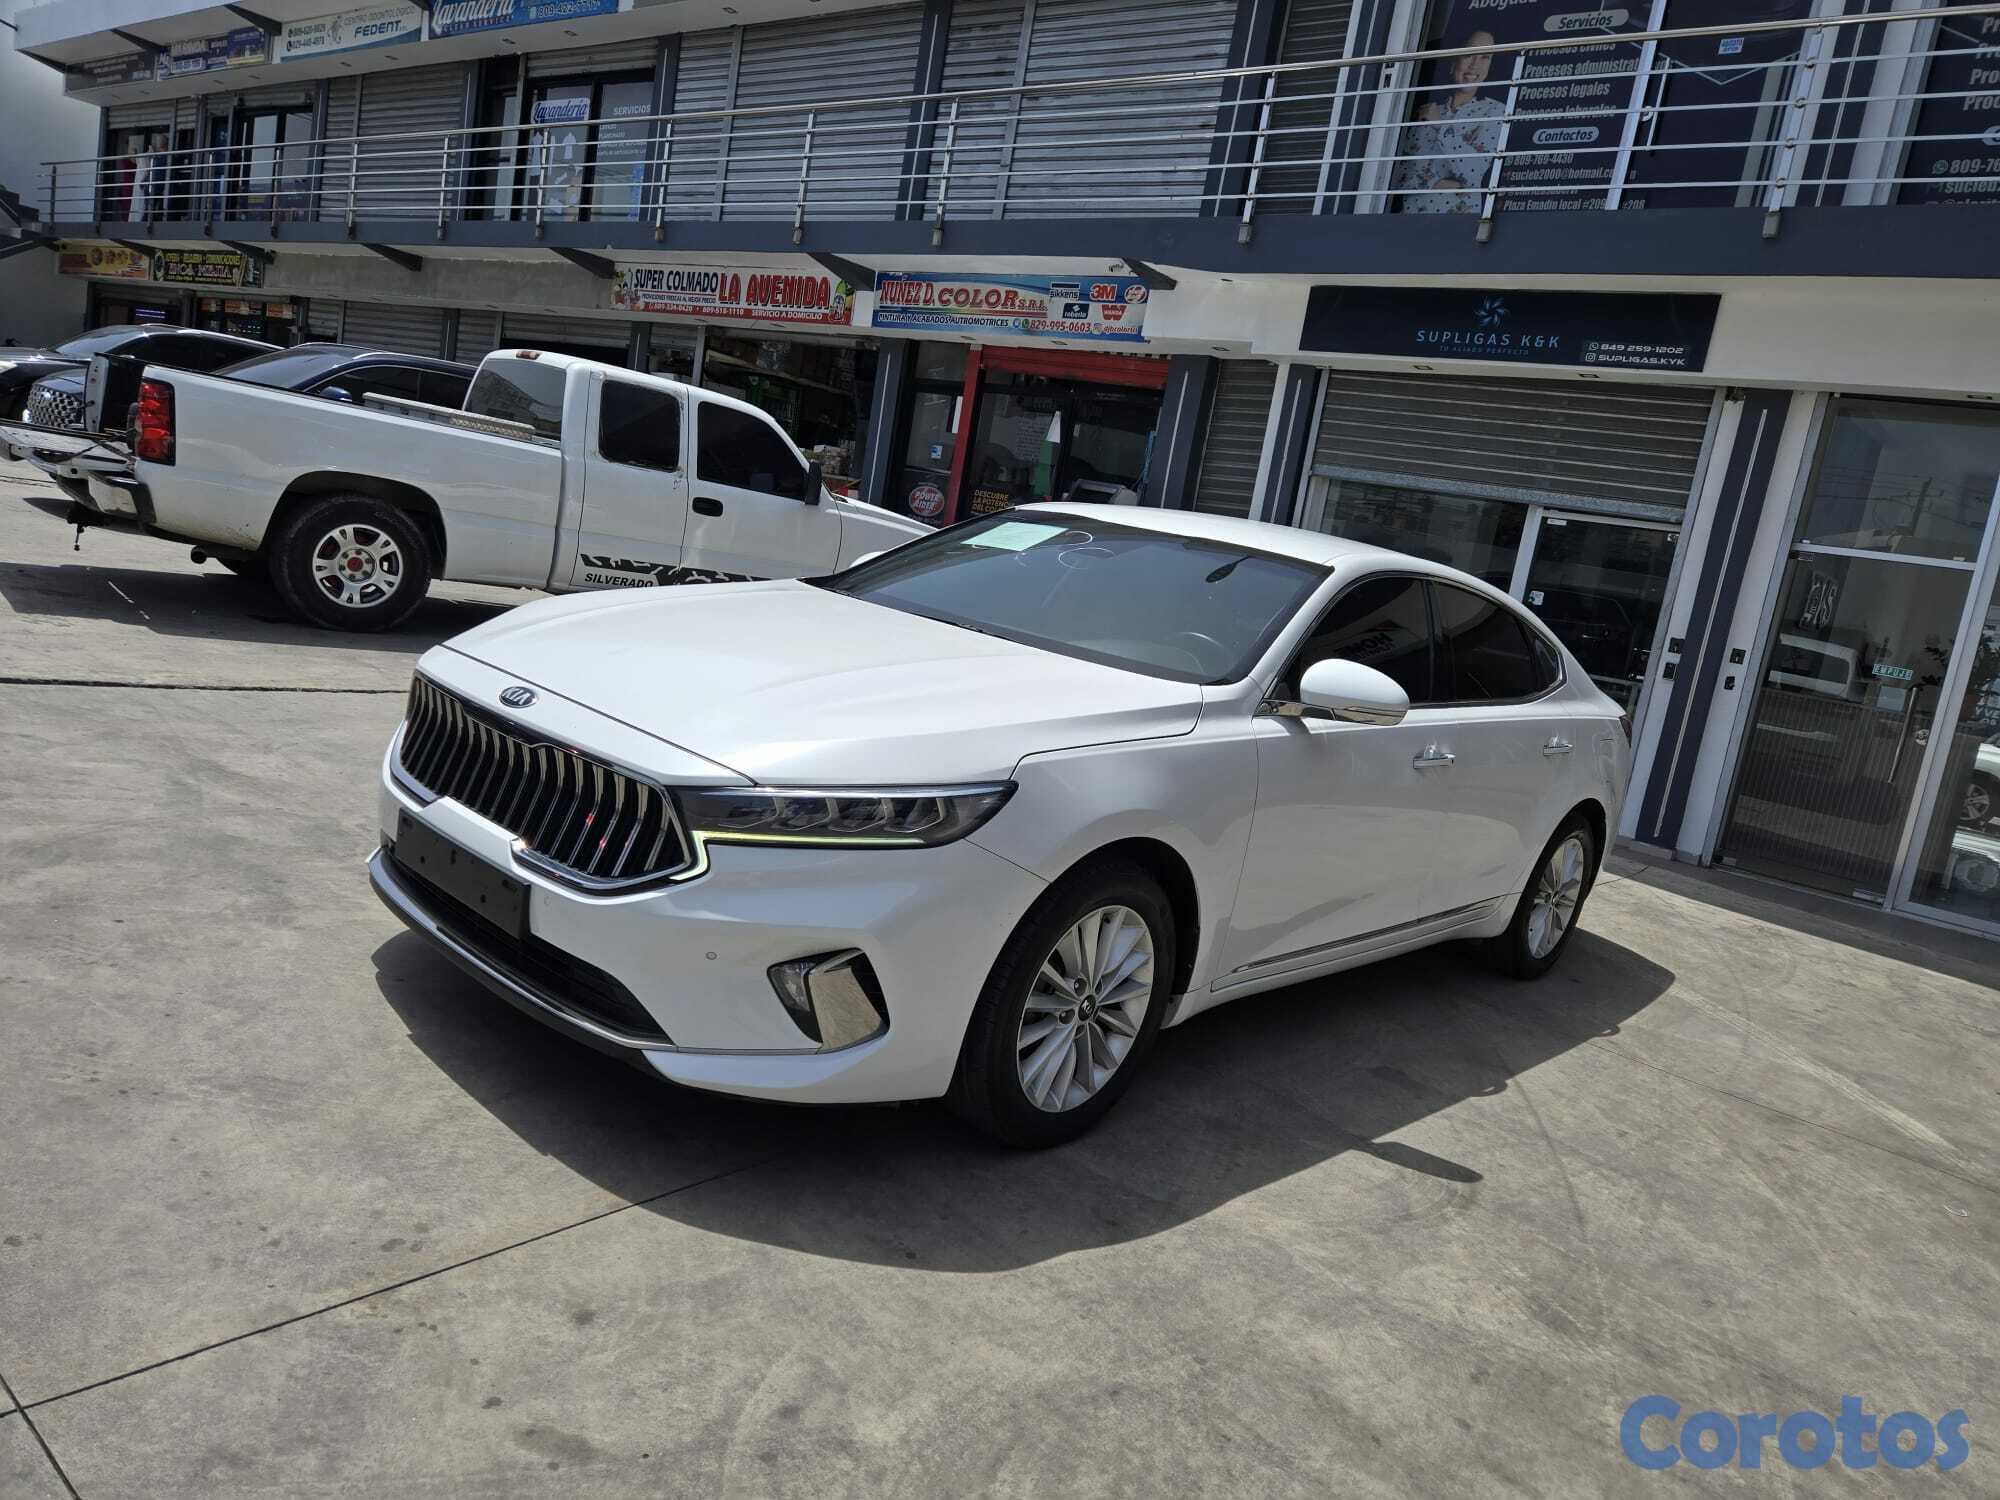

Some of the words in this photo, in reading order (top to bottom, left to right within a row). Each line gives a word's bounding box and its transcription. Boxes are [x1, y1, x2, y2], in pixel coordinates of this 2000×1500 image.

[1558, 13, 1613, 30] Servicios
[1524, 63, 1573, 79] Procesos
[1519, 85, 1569, 101] Procesos
[1569, 80, 1611, 97] legales
[613, 104, 652, 116] SERVICIOS
[1537, 129, 1594, 142] Contactos
[1503, 199, 1526, 210] Plaza
[1558, 198, 1582, 209] local
[634, 268, 665, 289] SUPER
[666, 270, 719, 293] COLMADO
[718, 272, 741, 305] LA
[745, 274, 831, 310] AVENIDA
[1090, 283, 1116, 301] 3M
[938, 287, 1019, 308] COLOR
[751, 309, 780, 318] SERVICIO
[787, 312, 823, 320] DOMICILIO
[912, 314, 949, 324] ACABADOS
[1030, 319, 1091, 333] 829-995-0603
[1416, 330, 1511, 346] SUPLIGAS
[1521, 335, 1560, 348] K&K
[1600, 343, 1625, 351] 849
[1627, 345, 1684, 354] 259-1202
[1598, 354, 1686, 366] SUPLIGAS.KYK
[974, 489, 1009, 500] DESCUBRE
[972, 503, 984, 512] DEL
[982, 498, 1012, 509] POTENC
[584, 573, 653, 588] SILVERADO
[1874, 664, 1911, 680] EMPUJE
[502, 688, 532, 706] KIA
